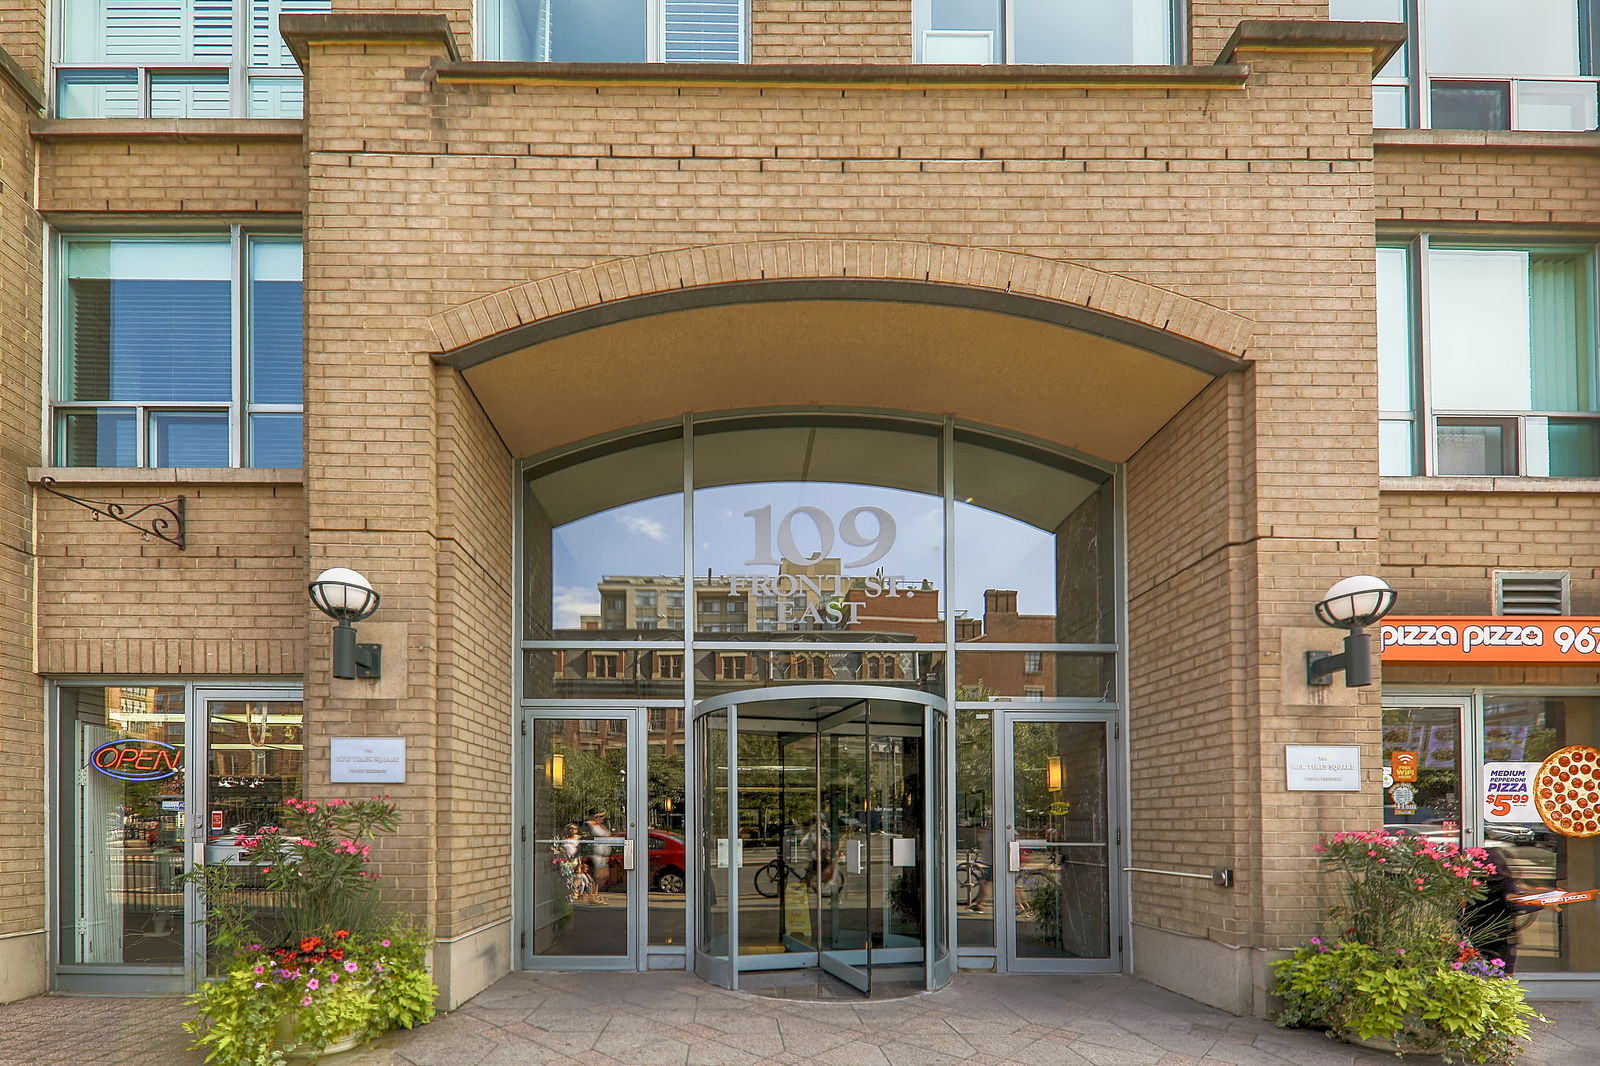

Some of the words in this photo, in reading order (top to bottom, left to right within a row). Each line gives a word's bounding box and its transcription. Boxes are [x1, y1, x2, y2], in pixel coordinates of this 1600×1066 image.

[744, 504, 897, 568] 109
[727, 574, 851, 597] FRONT
[865, 575, 915, 598] ST.
[775, 602, 866, 624] EAST
[1381, 625, 1458, 653] pizza
[1462, 625, 1544, 653] pizza
[96, 747, 181, 770] OPEN
[1328, 763, 1355, 771] SQUARE
[1488, 783, 1527, 792] PIZZA
